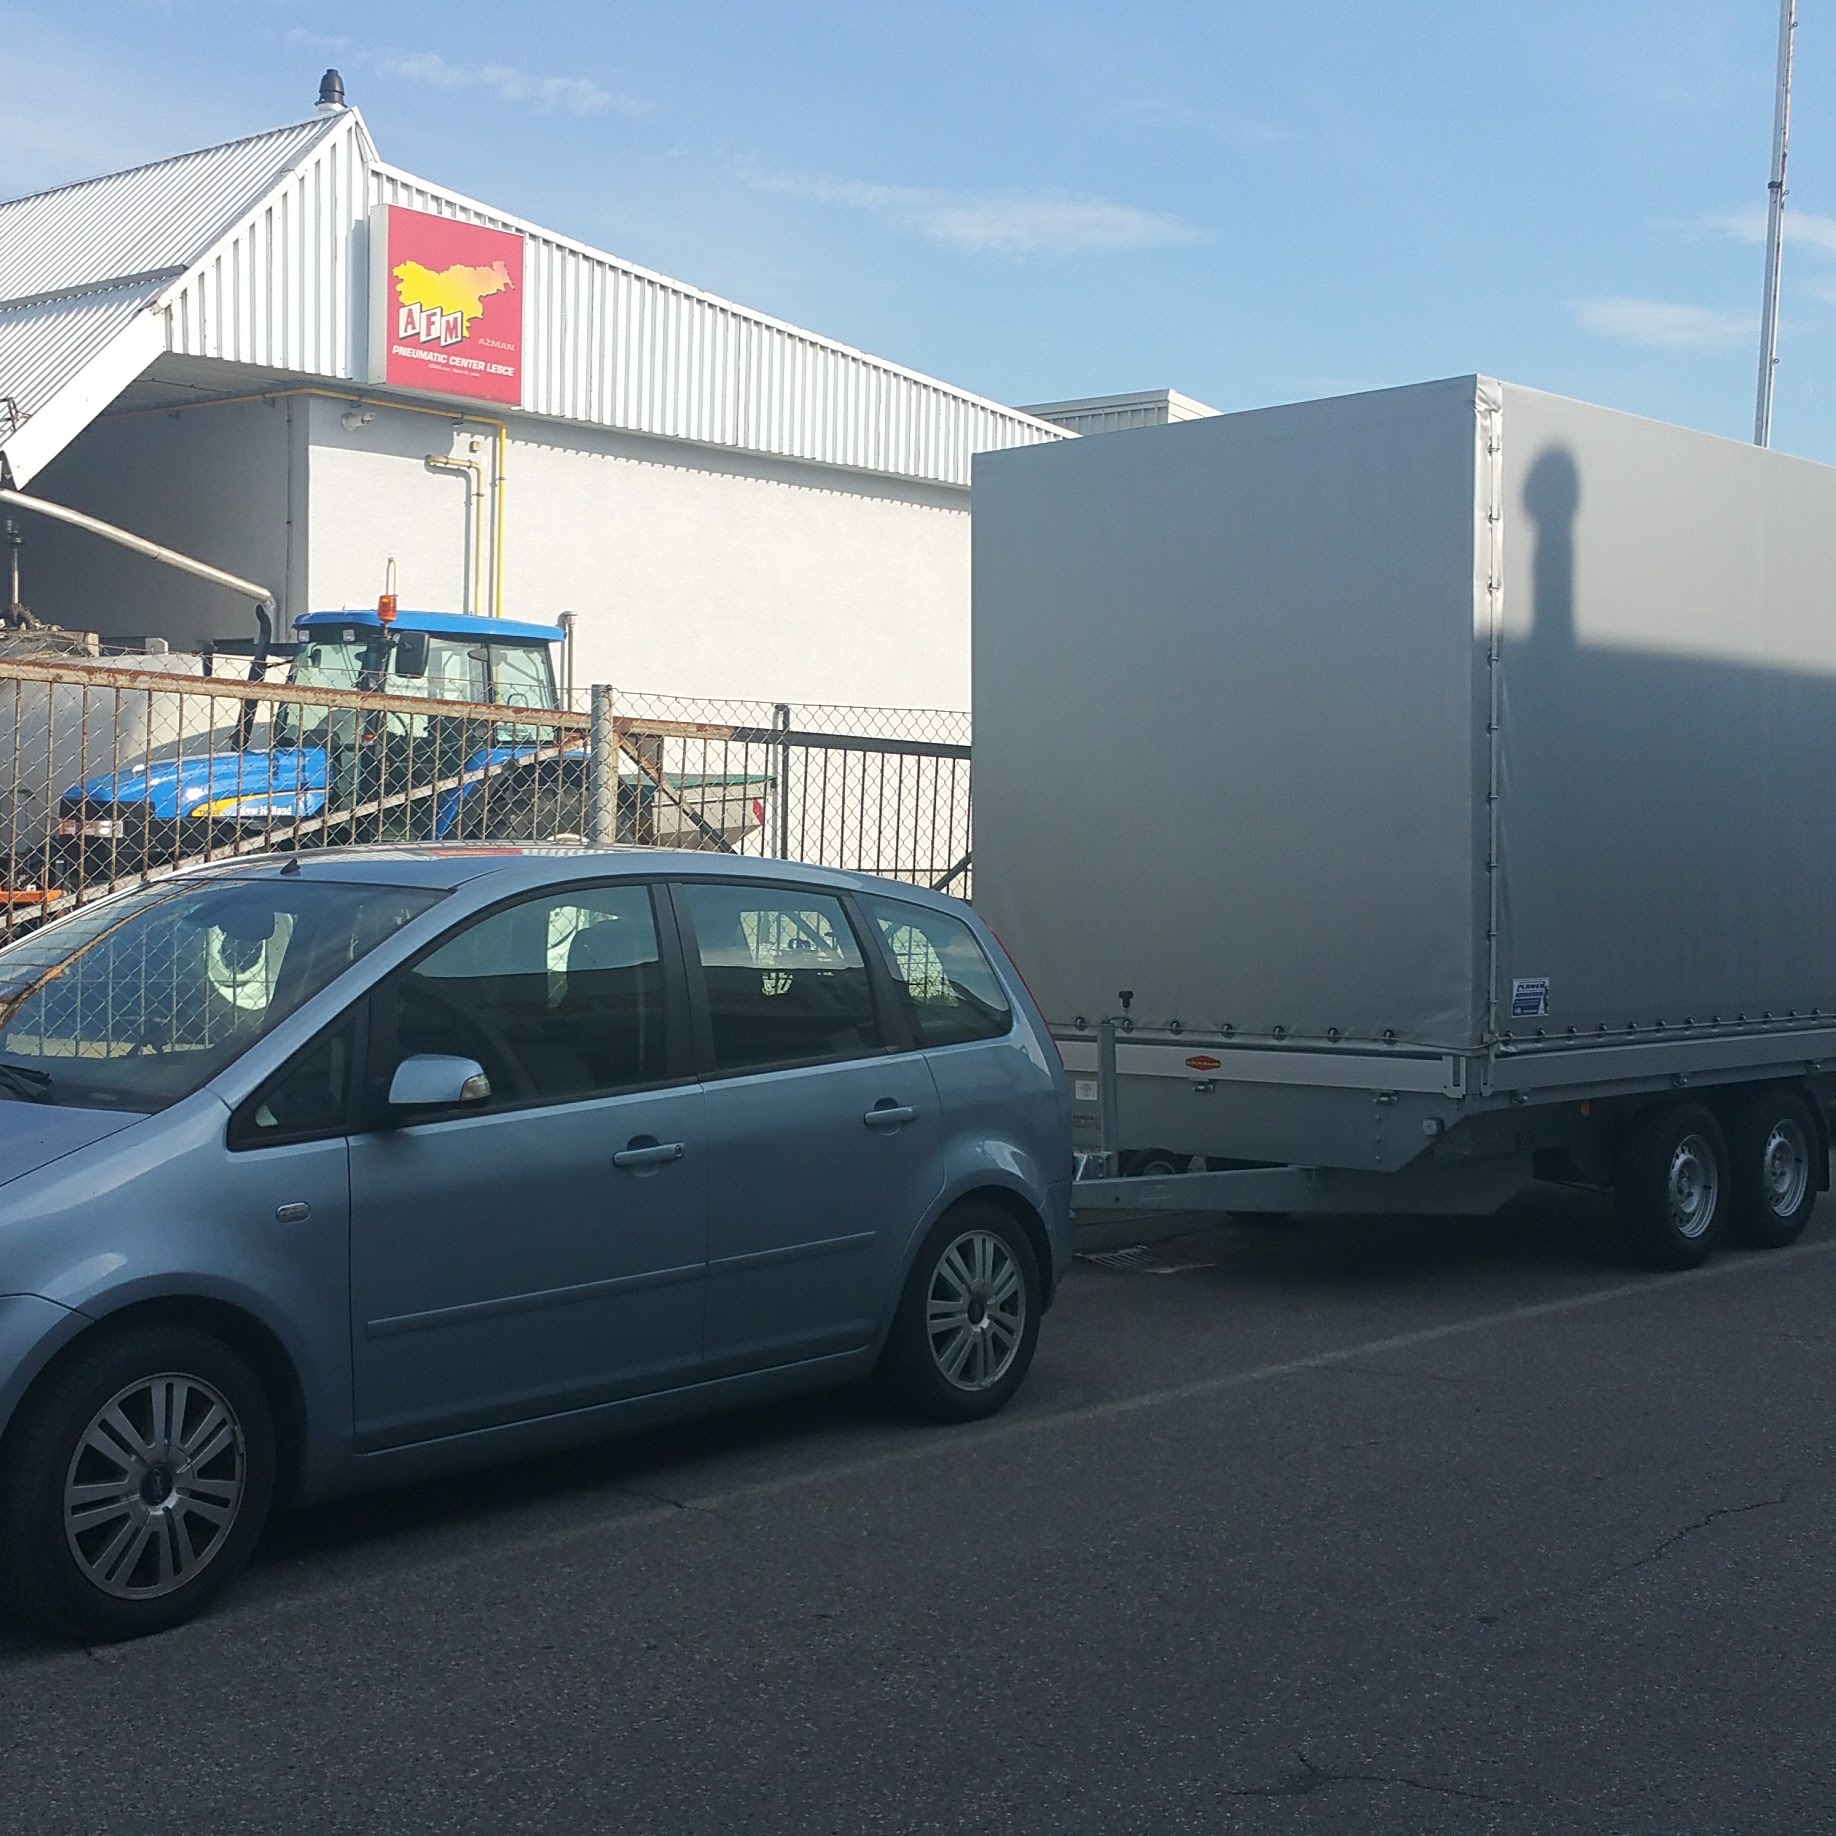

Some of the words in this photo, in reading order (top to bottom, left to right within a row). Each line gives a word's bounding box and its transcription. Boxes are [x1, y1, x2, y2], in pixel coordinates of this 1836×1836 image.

[403, 307, 460, 343] AFM
[392, 345, 448, 363] PNEUMATIC
[449, 356, 485, 370] CENTER
[486, 362, 515, 376] LESCE
[260, 805, 292, 816] Hlland
